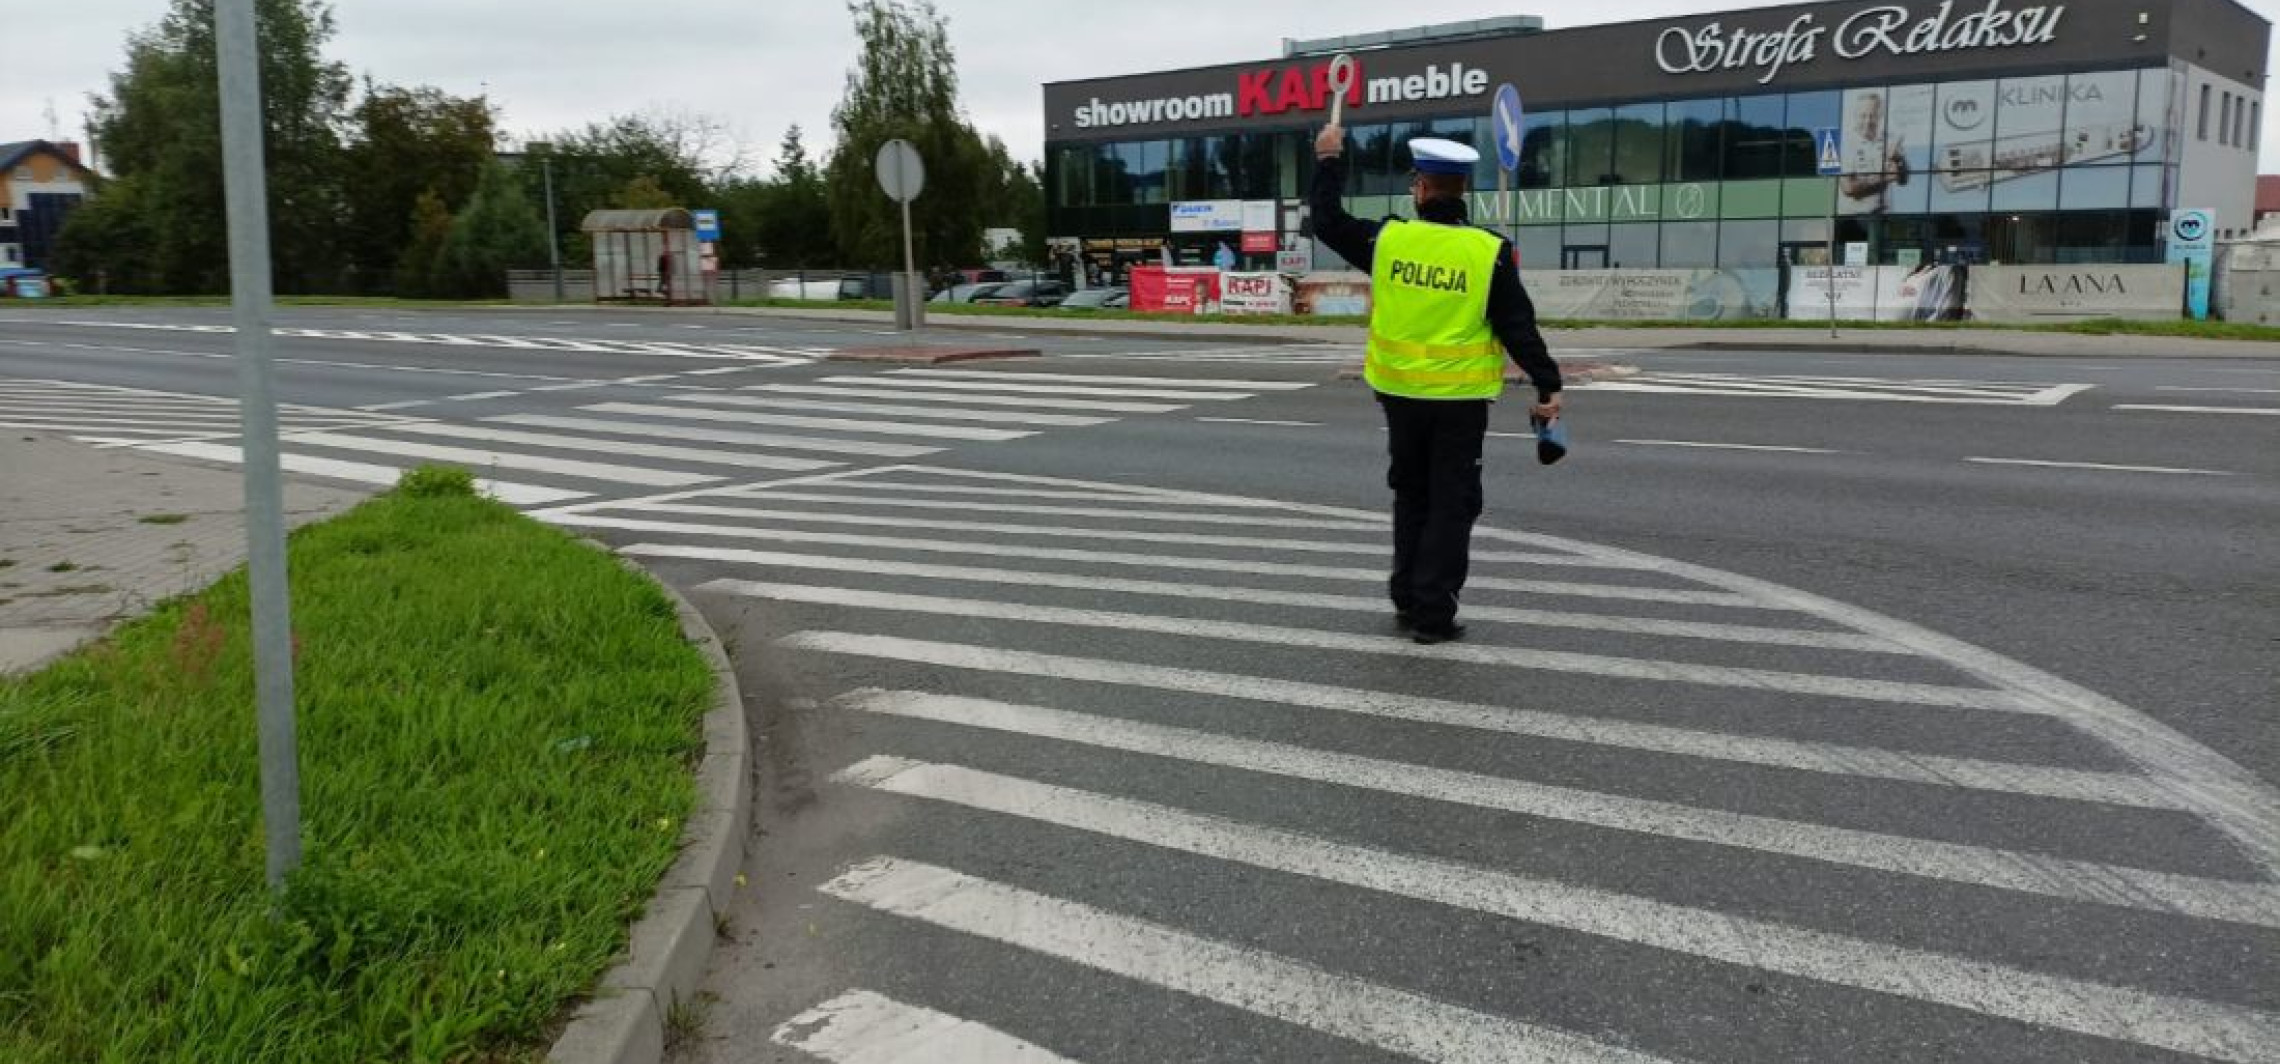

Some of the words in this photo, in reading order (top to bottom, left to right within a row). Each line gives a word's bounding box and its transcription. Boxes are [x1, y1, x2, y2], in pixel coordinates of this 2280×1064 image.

[1655, 13, 1826, 84] Strefa
[1832, 0, 2065, 58] Relaksu
[1075, 91, 1233, 128] showroom
[1367, 63, 1489, 102] meble
[2000, 83, 2103, 106] KLINIKA
[1228, 275, 1272, 296] KAPI
[1389, 258, 1467, 293] POLICJA
